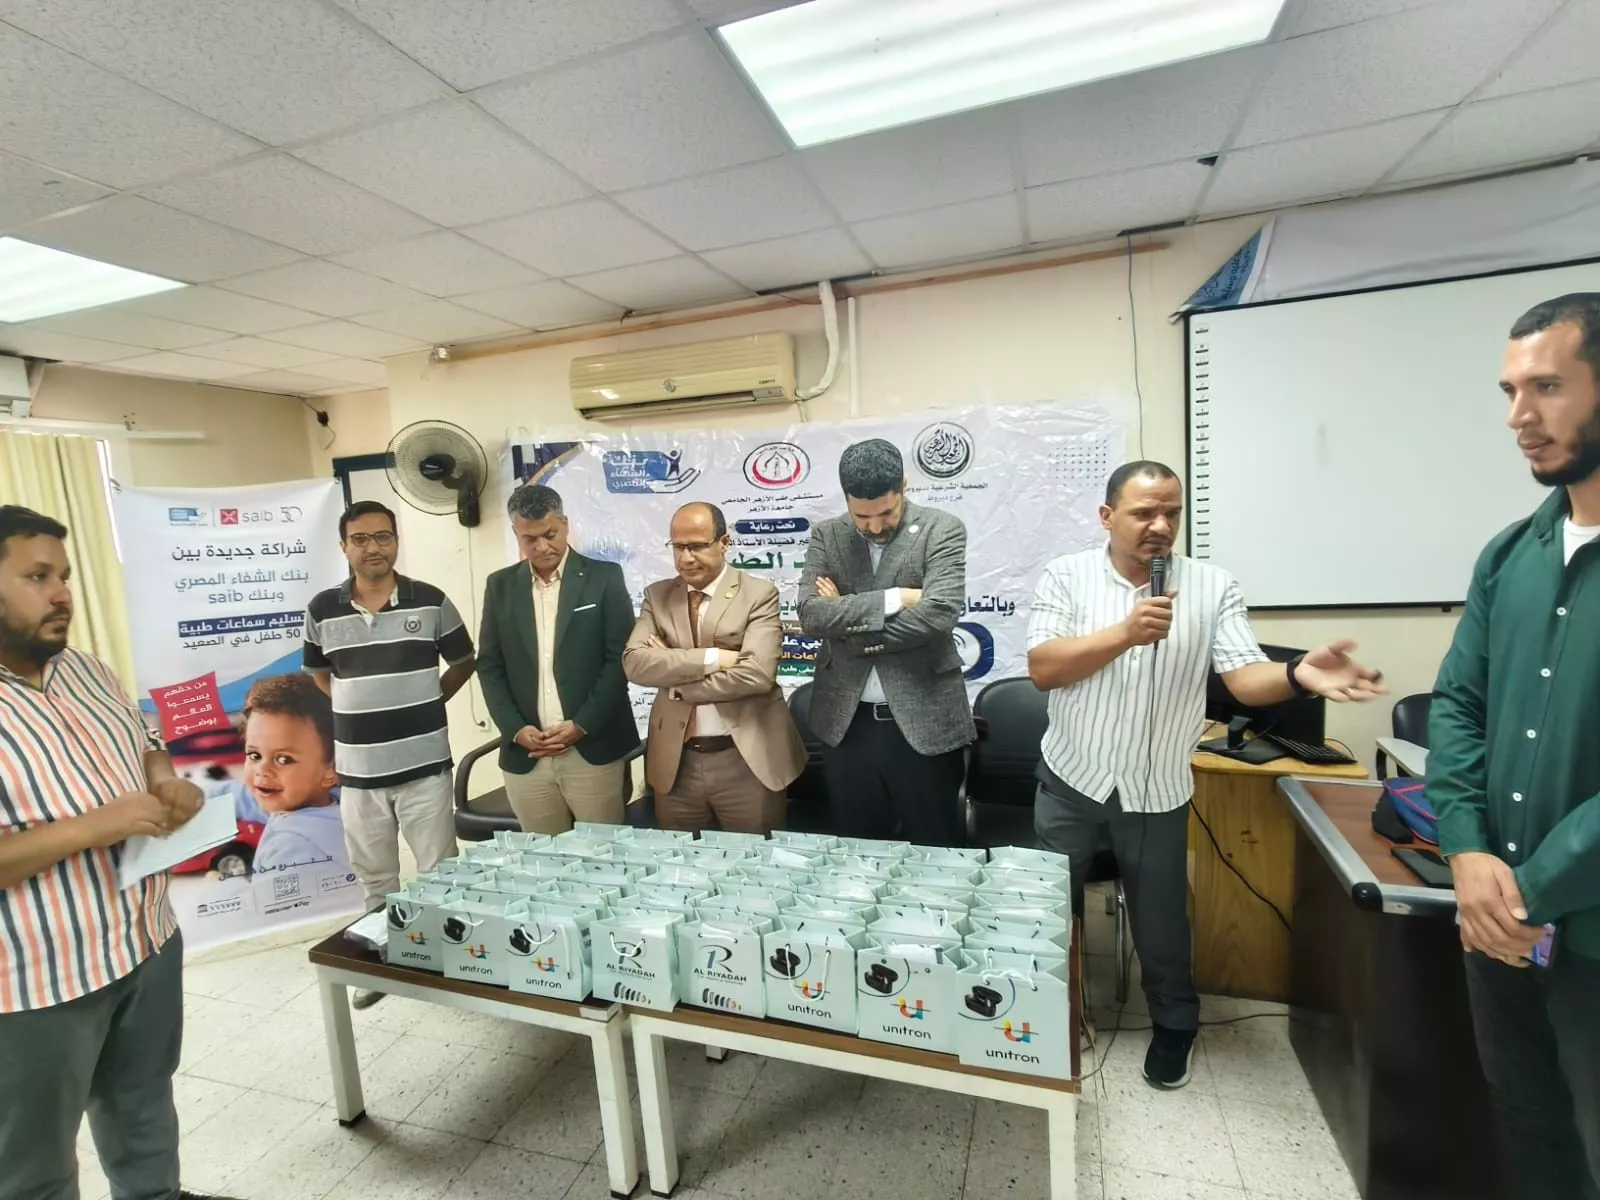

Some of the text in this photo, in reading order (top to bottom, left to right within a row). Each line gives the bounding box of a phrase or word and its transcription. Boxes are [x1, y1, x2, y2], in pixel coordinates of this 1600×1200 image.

[242, 509, 274, 523] saib
[749, 520, 796, 532] تحت رعاية
[766, 536, 795, 547] فضيلة
[172, 539, 307, 561] شراكة جديدة بين
[174, 568, 309, 592] بنك الشفاء المصري
[208, 589, 285, 604] وبنك saib
[960, 595, 1015, 617] وبالتعاو
[180, 621, 213, 635] طبية
[216, 617, 266, 631] سماعات
[183, 628, 301, 650] 50 طفل في الصعيد
[163, 680, 208, 699] من حقهم
[401, 950, 432, 962] unitron
[459, 964, 493, 976] unitron
[618, 965, 655, 979] RIYADAH
[693, 968, 705, 976] AL
[707, 972, 747, 982] RIYADAH
[525, 977, 562, 990] unitron
[787, 1002, 832, 1019] unitron
[882, 1024, 932, 1040] unitron
[985, 1048, 1041, 1065] unitron
